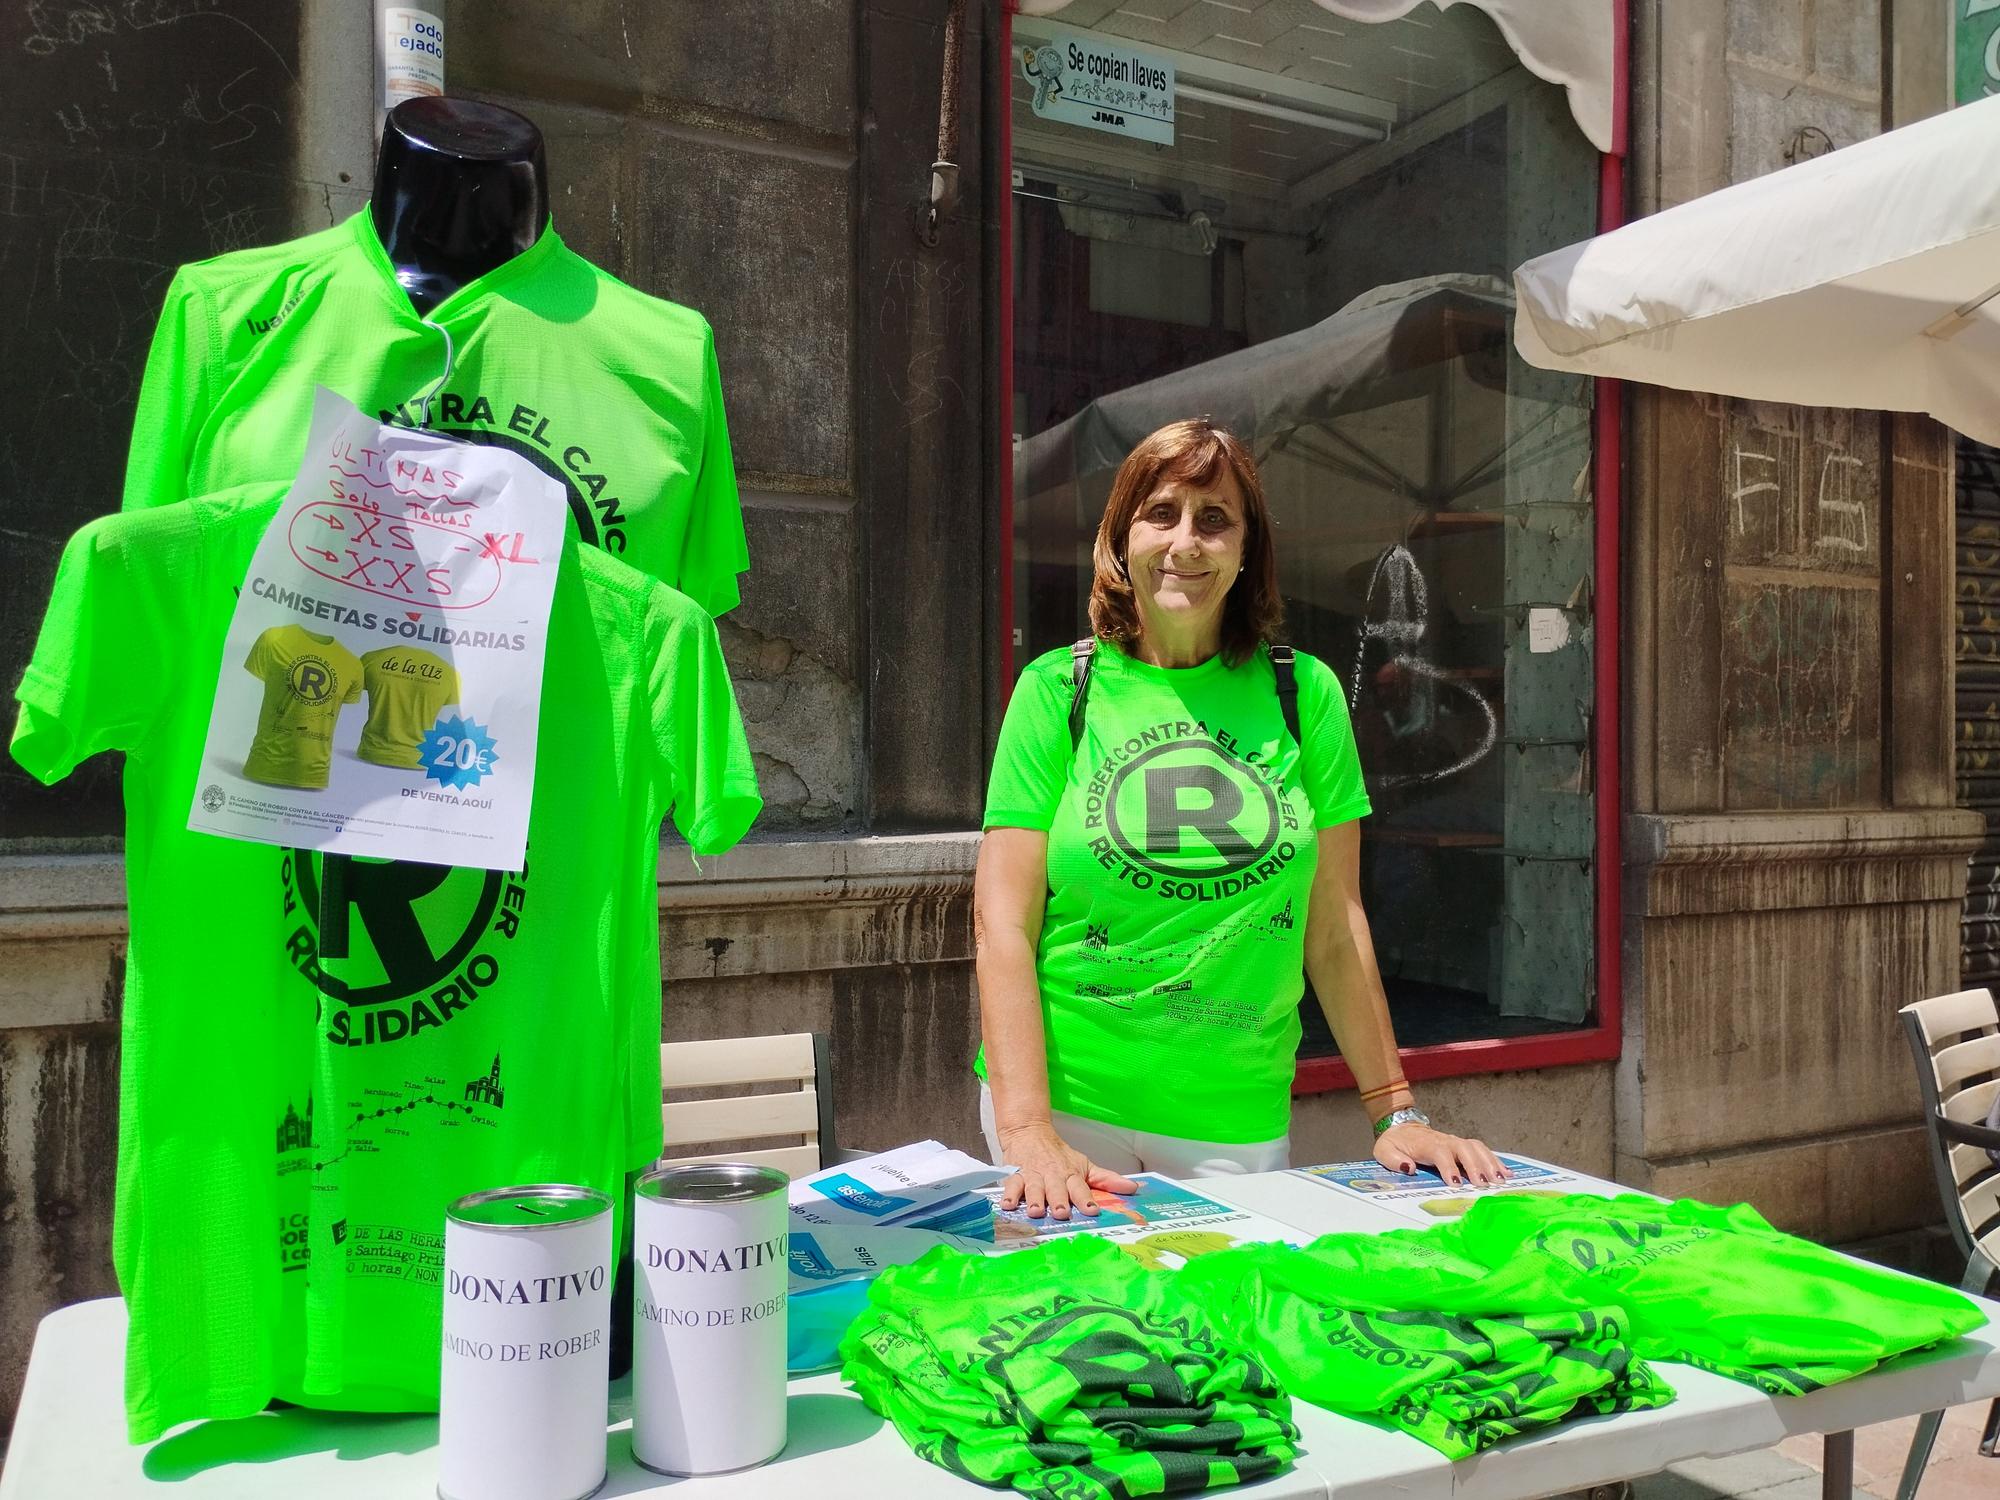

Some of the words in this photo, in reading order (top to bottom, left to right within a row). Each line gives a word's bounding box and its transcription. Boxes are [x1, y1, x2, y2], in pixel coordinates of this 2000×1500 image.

[1068, 42, 1084, 71] Se
[1088, 52, 1128, 84] copian
[1132, 58, 1166, 91] llaves
[1091, 111, 1126, 128] JMA
[507, 405, 552, 448] EL
[351, 512, 414, 550] XS
[479, 532, 540, 564] XL
[341, 549, 451, 596] XXS
[252, 577, 377, 630] CAMISETAS
[383, 617, 526, 651] SOLIDARIAS
[300, 665, 326, 699] R
[381, 656, 398, 671] de
[402, 658, 416, 675] la
[432, 735, 488, 772] 20€
[1085, 756, 1119, 829] ROBER
[1114, 720, 1210, 761] CONTRA
[1216, 728, 1239, 753] EL
[289, 806, 313, 815] CONTRA
[401, 787, 418, 799] DE
[420, 790, 460, 806] VENTA
[462, 797, 494, 810] AQUÍ
[1145, 764, 1258, 860] R
[1088, 835, 1154, 890] RETO
[1158, 841, 1296, 902] SOLIDARIO
[354, 1227, 370, 1240] DE
[379, 1228, 404, 1241] LAS
[1127, 1212, 1252, 1234] SOLIDARIAS
[354, 1244, 416, 1263] Santiago
[648, 1232, 788, 1273] DONATIVO
[449, 1265, 605, 1306] DONATIVO
[636, 1297, 700, 1327] CAMINO
[706, 1307, 734, 1327] DE
[741, 1291, 788, 1322] ROBER
[500, 1344, 531, 1362] DE
[538, 1328, 601, 1361] ROBER
